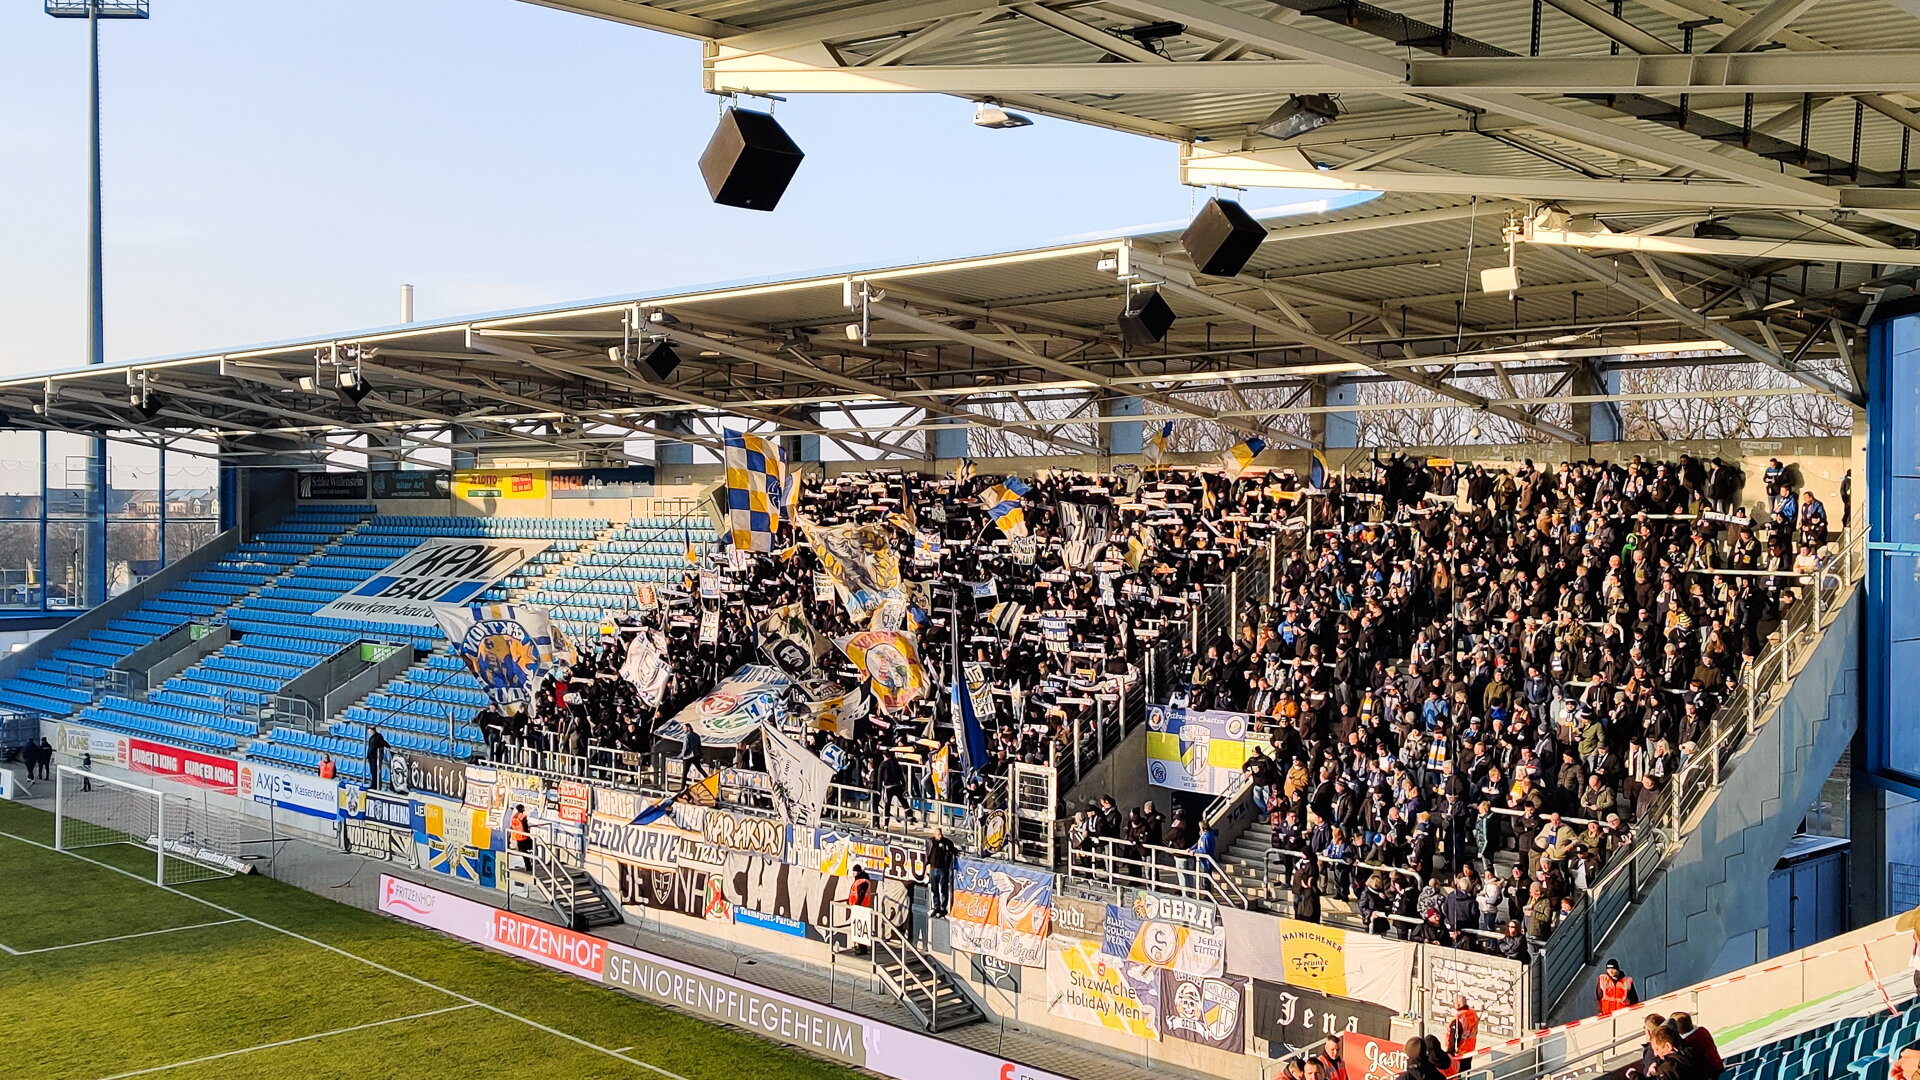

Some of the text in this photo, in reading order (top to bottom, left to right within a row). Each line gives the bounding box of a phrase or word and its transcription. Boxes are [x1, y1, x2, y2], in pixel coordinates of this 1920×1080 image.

[413, 481, 425, 489] Art
[478, 475, 497, 485] LOTTO
[401, 545, 519, 579] KPM
[377, 577, 459, 601] BAU
[1166, 711, 1197, 723] Ostbayern
[132, 748, 159, 767] BURGER
[159, 754, 177, 772] KING
[184, 760, 234, 785] BURGER KING
[256, 772, 281, 793] AXIS
[294, 783, 335, 803] Kassentechnik
[347, 826, 391, 851] WOLFPACK
[704, 810, 784, 856] HARAKIRI
[680, 837, 728, 866] ULTRAS
[395, 883, 437, 908] FRITZENHOF
[1158, 898, 1214, 929] GERA
[852, 918, 869, 940] 19A
[1106, 925, 1136, 940] GOLDEN
[498, 916, 602, 969] FRITZENHOF
[1281, 931, 1343, 954] HAINICHENER
[1291, 957, 1329, 970] Freunde
[1069, 970, 1137, 1000] SitzwAche
[609, 955, 854, 1058] SENIORENPFLEGEHEIM
[1066, 989, 1140, 1021] HolidAy Men
[1276, 991, 1359, 1036] Jena
